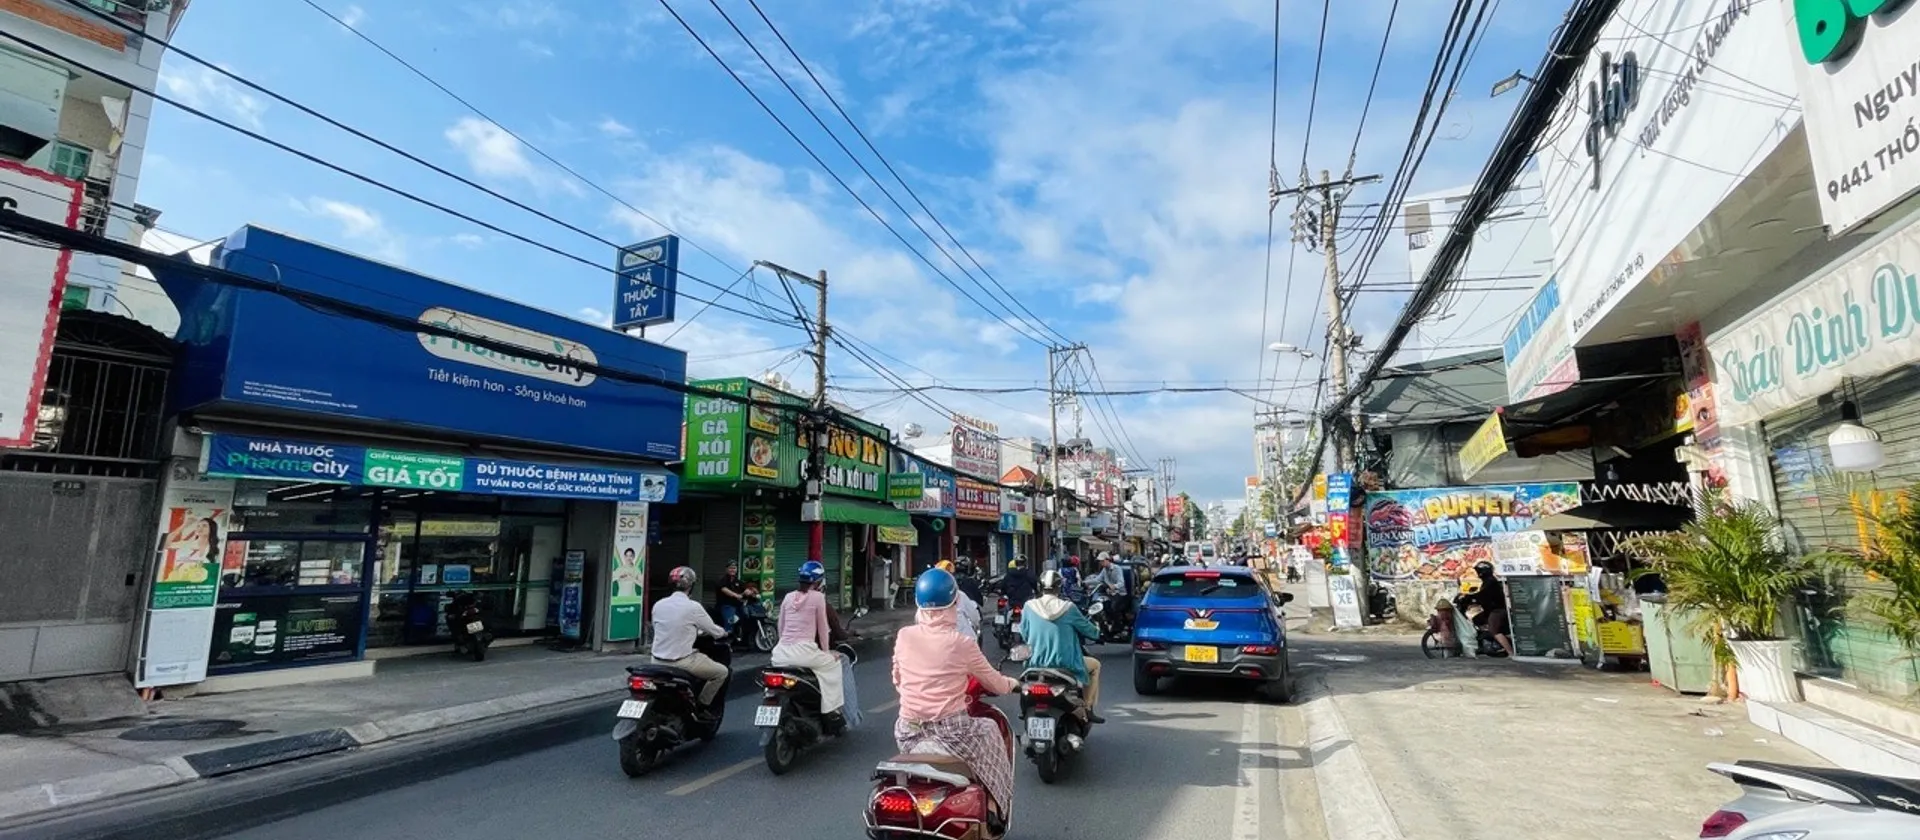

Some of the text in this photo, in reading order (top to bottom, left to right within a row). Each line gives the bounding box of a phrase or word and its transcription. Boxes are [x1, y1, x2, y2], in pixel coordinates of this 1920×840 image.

[1854, 56, 1920, 129] Nguy
[1840, 117, 1920, 195] 441 THỐ
[623, 285, 658, 304] THUỐC
[629, 303, 649, 319] TÂY
[1786, 289, 1867, 375] Dinh
[702, 416, 729, 435] GÀ
[249, 441, 334, 458] NHÀ THUỐC
[227, 451, 350, 478] Pharmacity
[367, 464, 460, 488] GIÁ TỐT
[477, 462, 633, 486] ĐỦ THUỐC BỆNH MẠN TÍNH
[1424, 493, 1514, 520] BUFFET
[1337, 593, 1353, 605] XE
